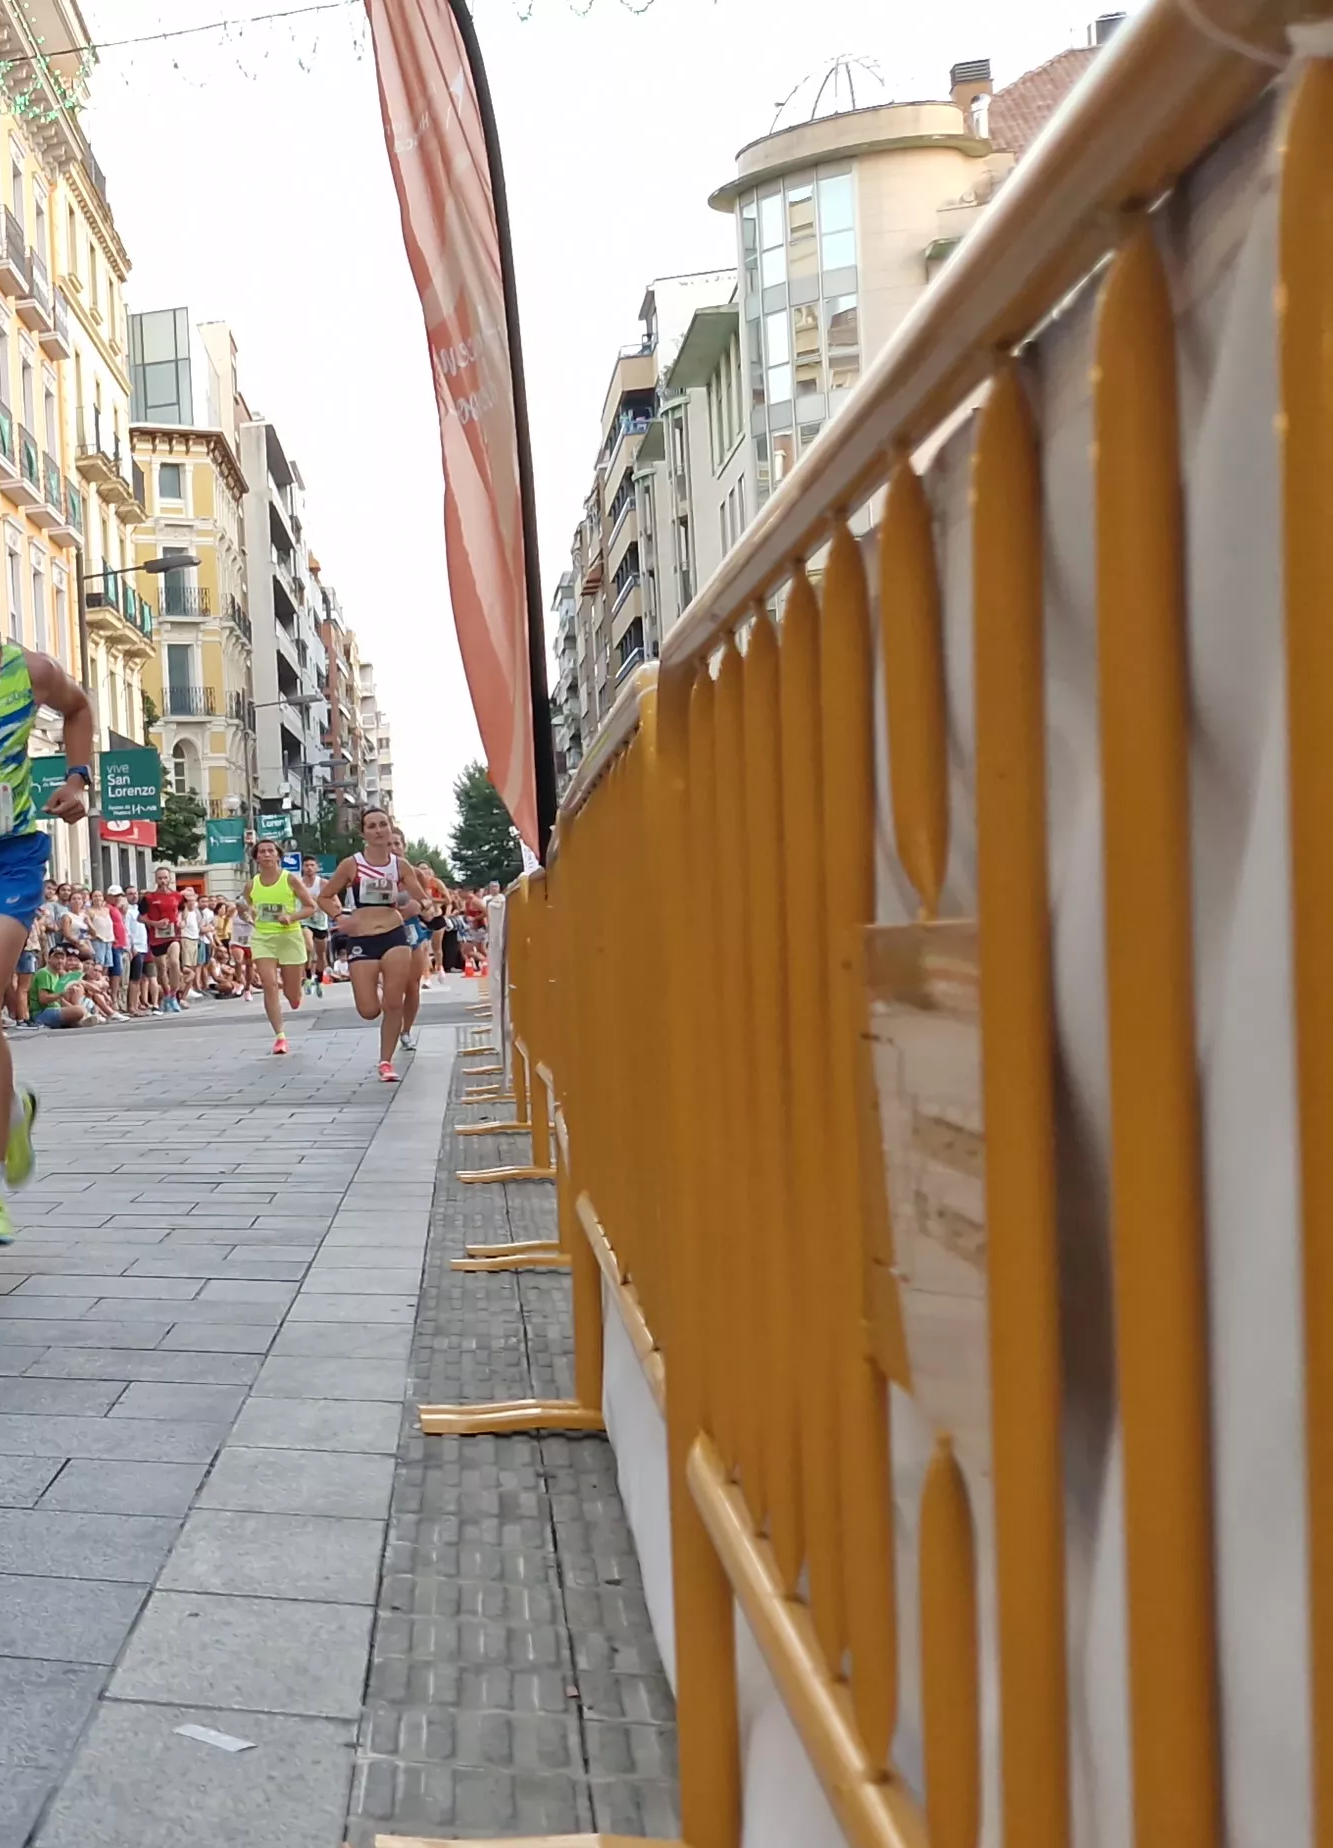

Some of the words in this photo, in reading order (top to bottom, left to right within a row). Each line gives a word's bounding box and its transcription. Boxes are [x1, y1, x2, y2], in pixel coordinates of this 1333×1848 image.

[107, 764, 130, 774] vive
[107, 774, 131, 786] San
[108, 786, 156, 798] Lorenzo
